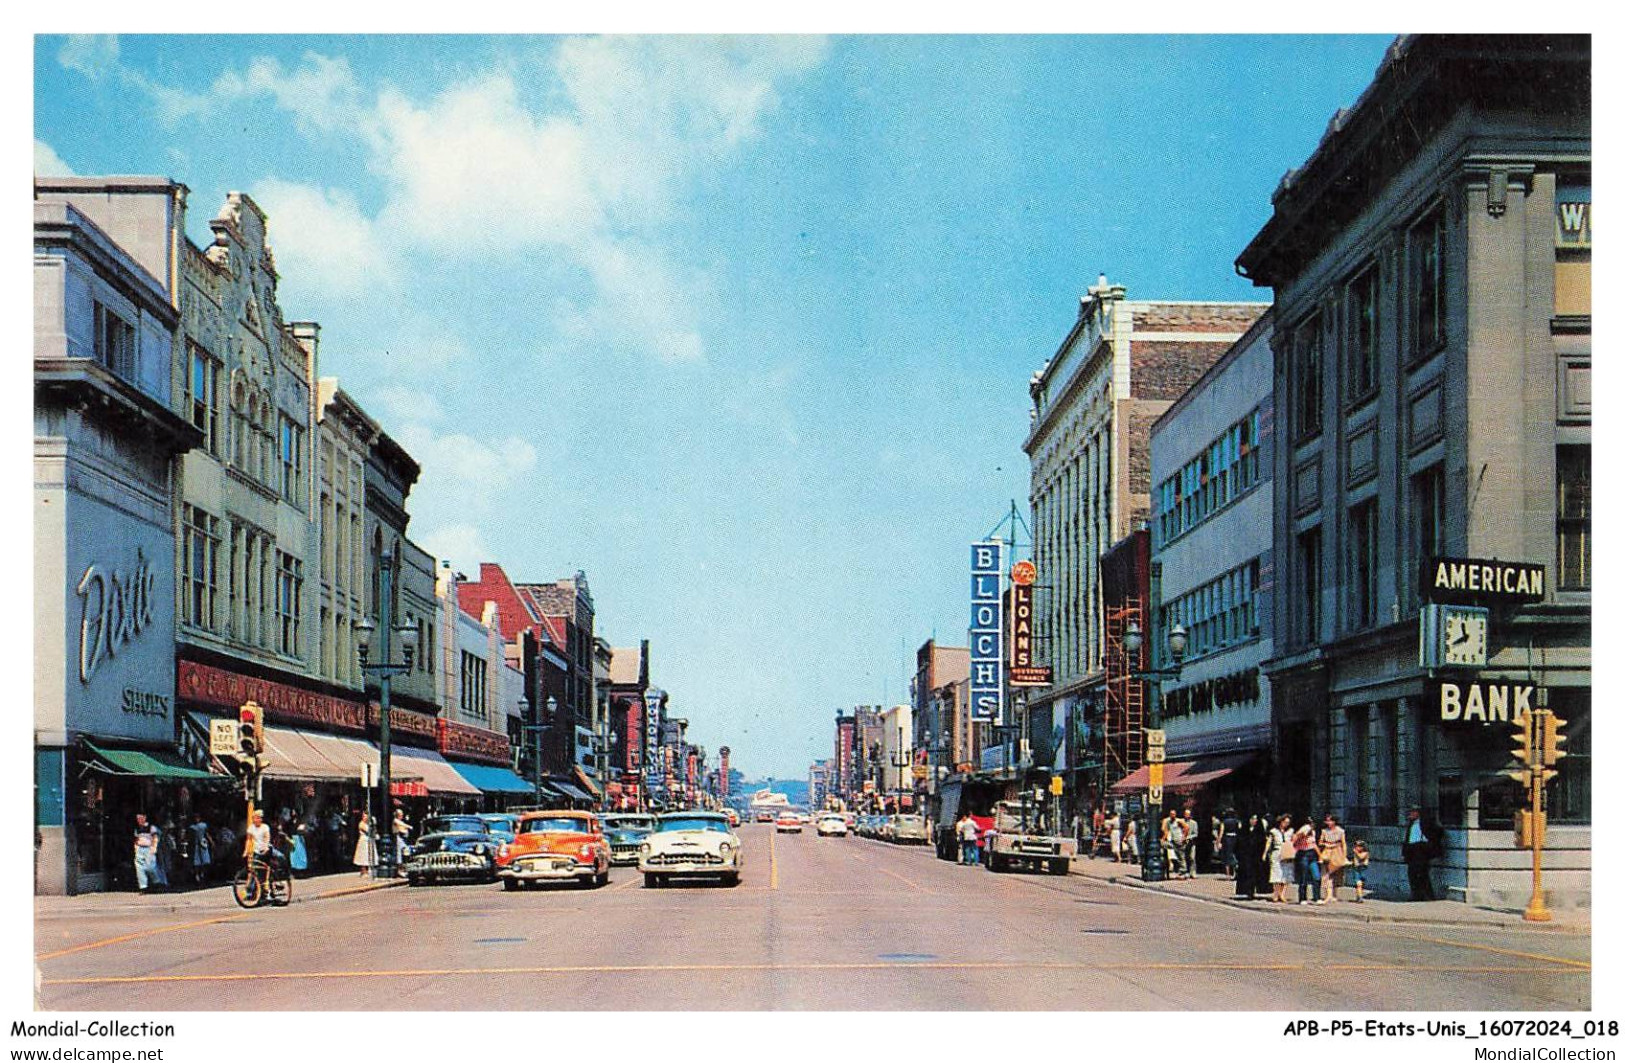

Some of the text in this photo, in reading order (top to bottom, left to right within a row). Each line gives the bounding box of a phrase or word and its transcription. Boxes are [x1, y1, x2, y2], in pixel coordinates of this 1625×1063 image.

[1434, 562, 1543, 595] AMERICAN
[1017, 589, 1030, 666] LOANS
[121, 687, 169, 719] SHOES
[1441, 683, 1534, 722] BANK
[217, 725, 231, 733] NO
[214, 743, 235, 751] TURN
